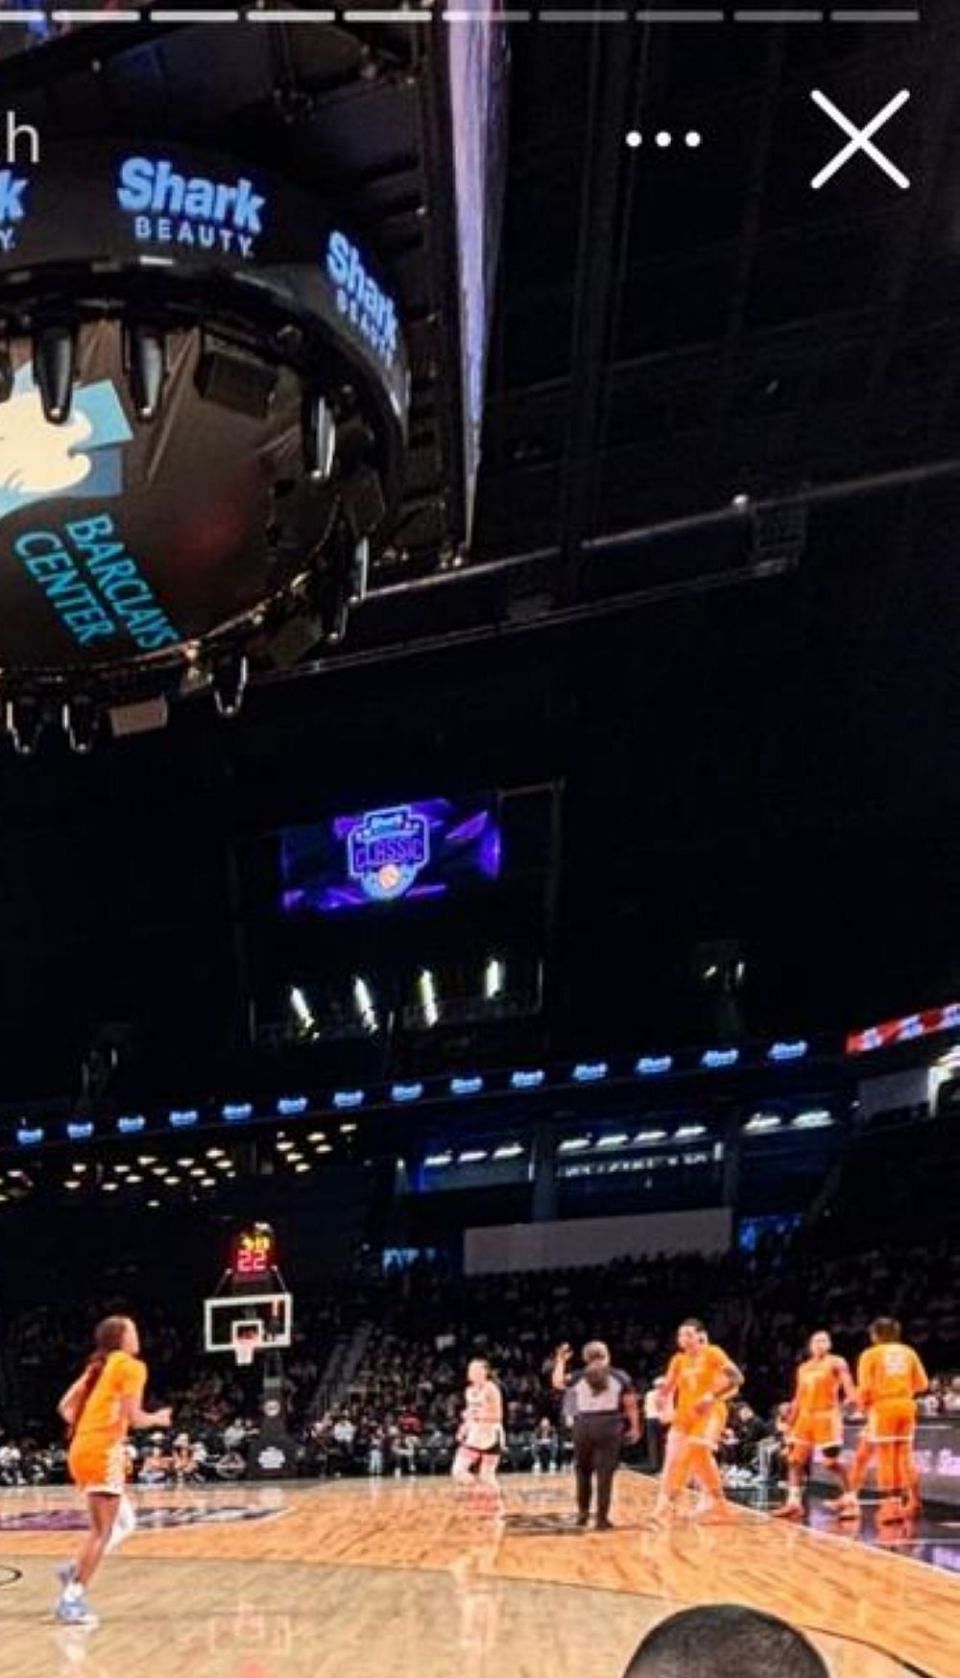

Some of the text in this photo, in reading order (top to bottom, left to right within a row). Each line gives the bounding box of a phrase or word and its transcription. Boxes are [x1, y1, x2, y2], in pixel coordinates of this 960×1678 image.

[117, 156, 265, 235] Shark
[134, 216, 253, 258] BEAUTY
[326, 230, 398, 350] Shark
[15, 531, 115, 647] CENTER
[65, 512, 180, 649] BARCLAYS
[354, 836, 424, 872] CLASSIC
